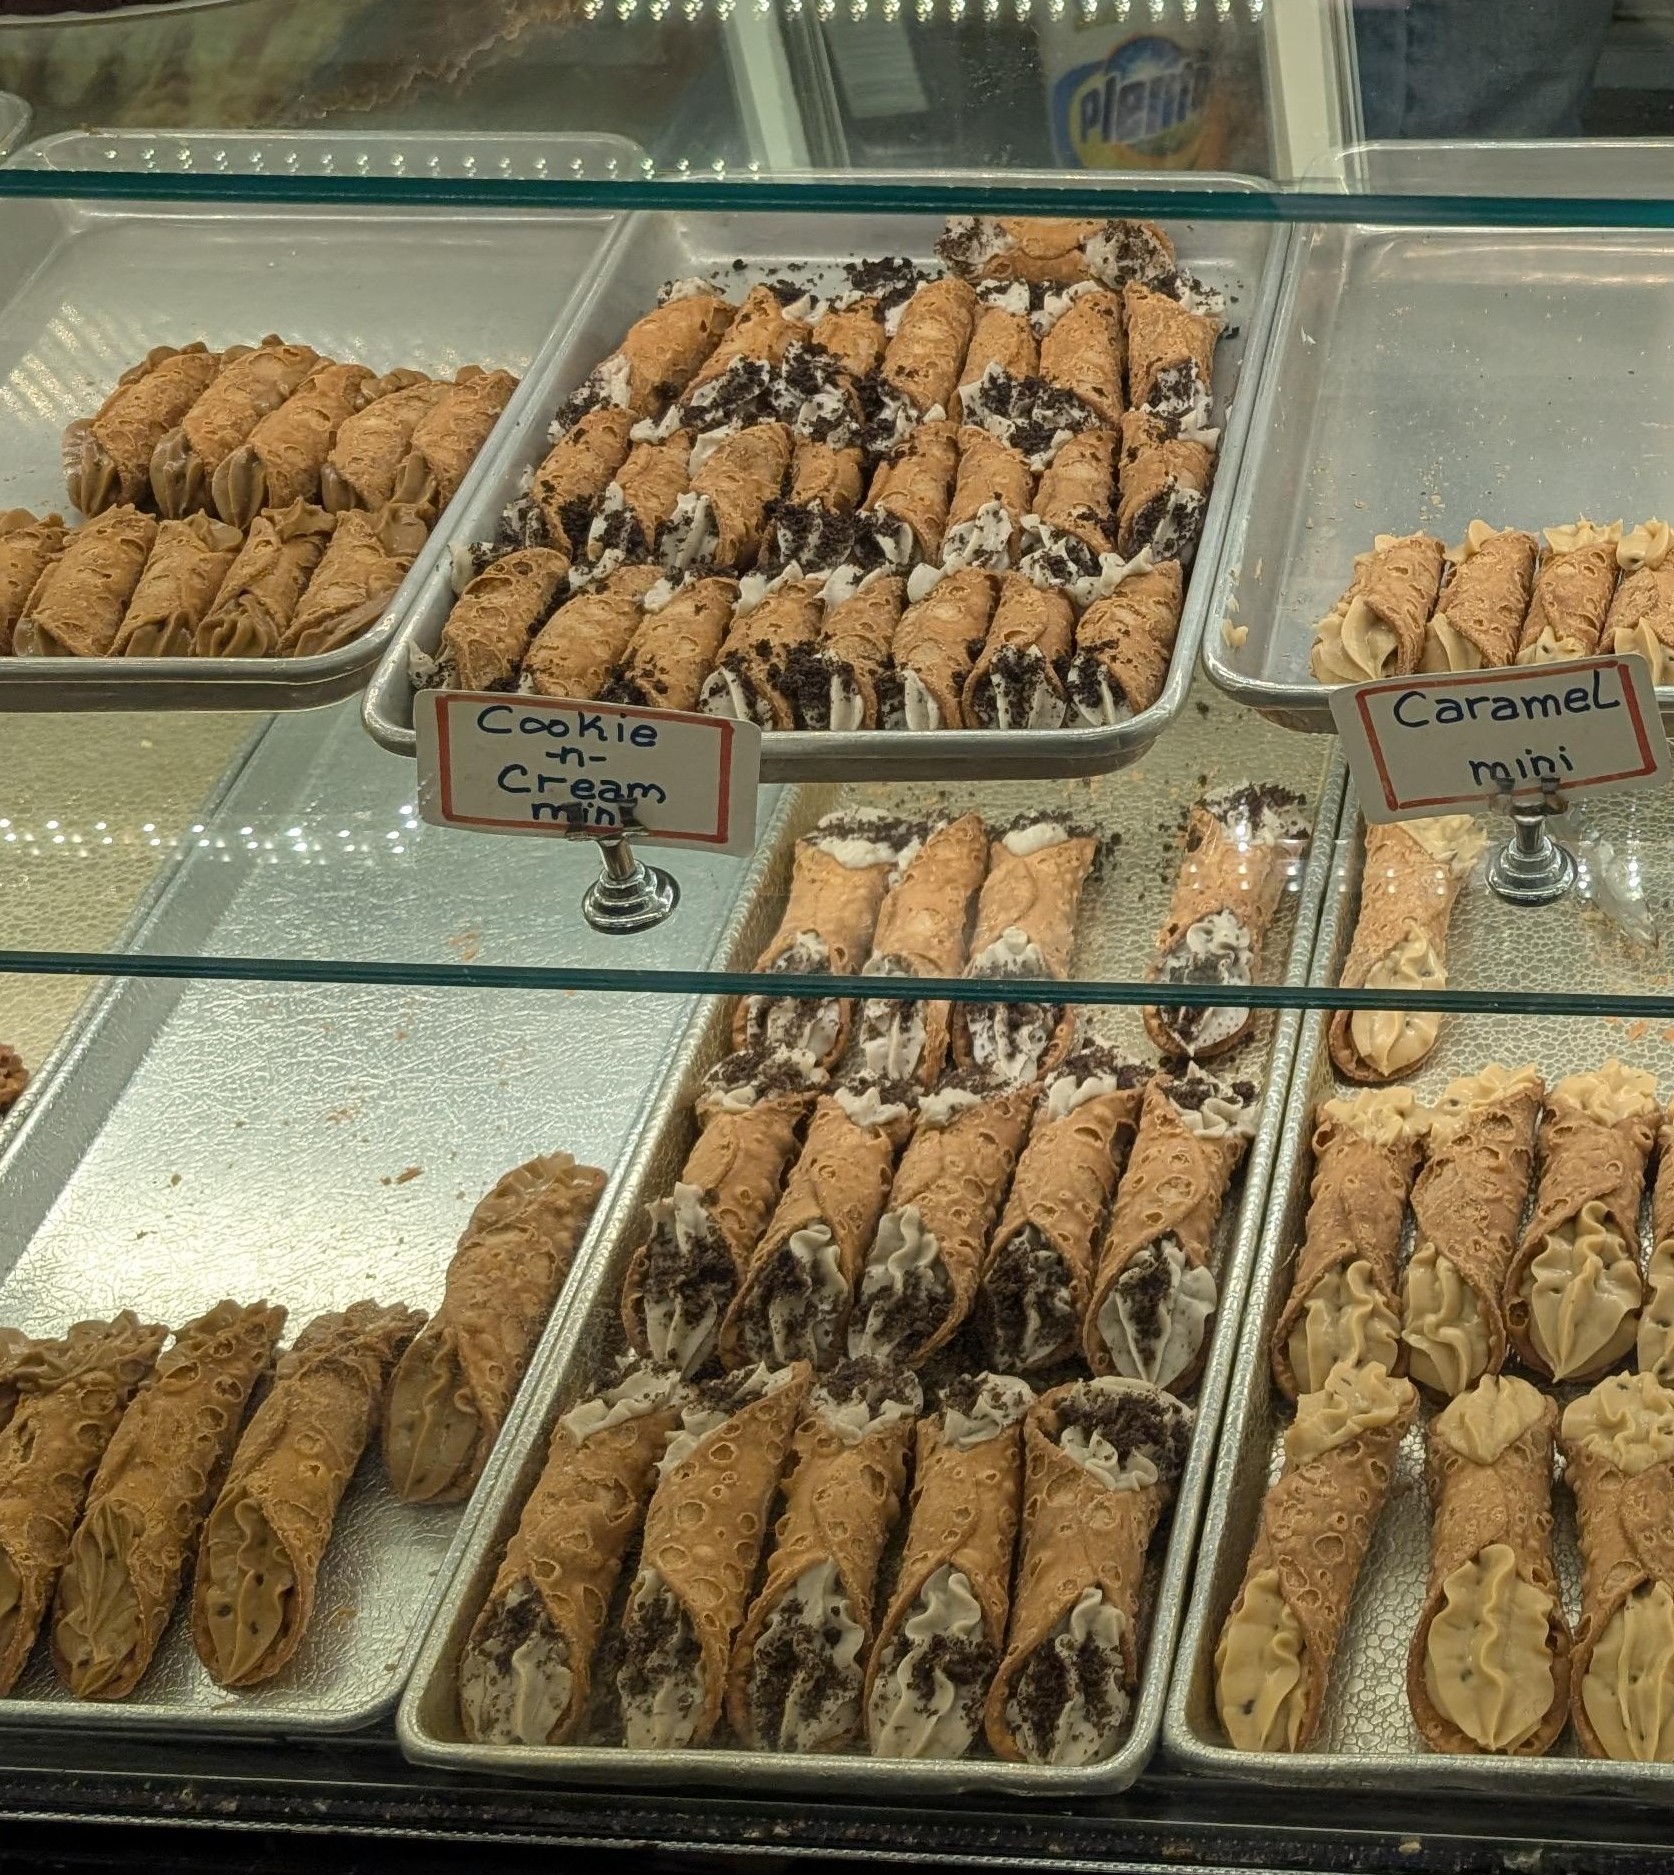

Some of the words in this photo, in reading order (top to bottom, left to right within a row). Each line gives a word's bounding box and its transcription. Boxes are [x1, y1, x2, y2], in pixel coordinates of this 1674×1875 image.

[1393, 669, 1621, 728] Caramel
[477, 705, 658, 748] Cookie
[545, 745, 607, 769] -n-
[1468, 745, 1574, 787] mini
[497, 763, 667, 804] Cream
[531, 801, 619, 826] min
